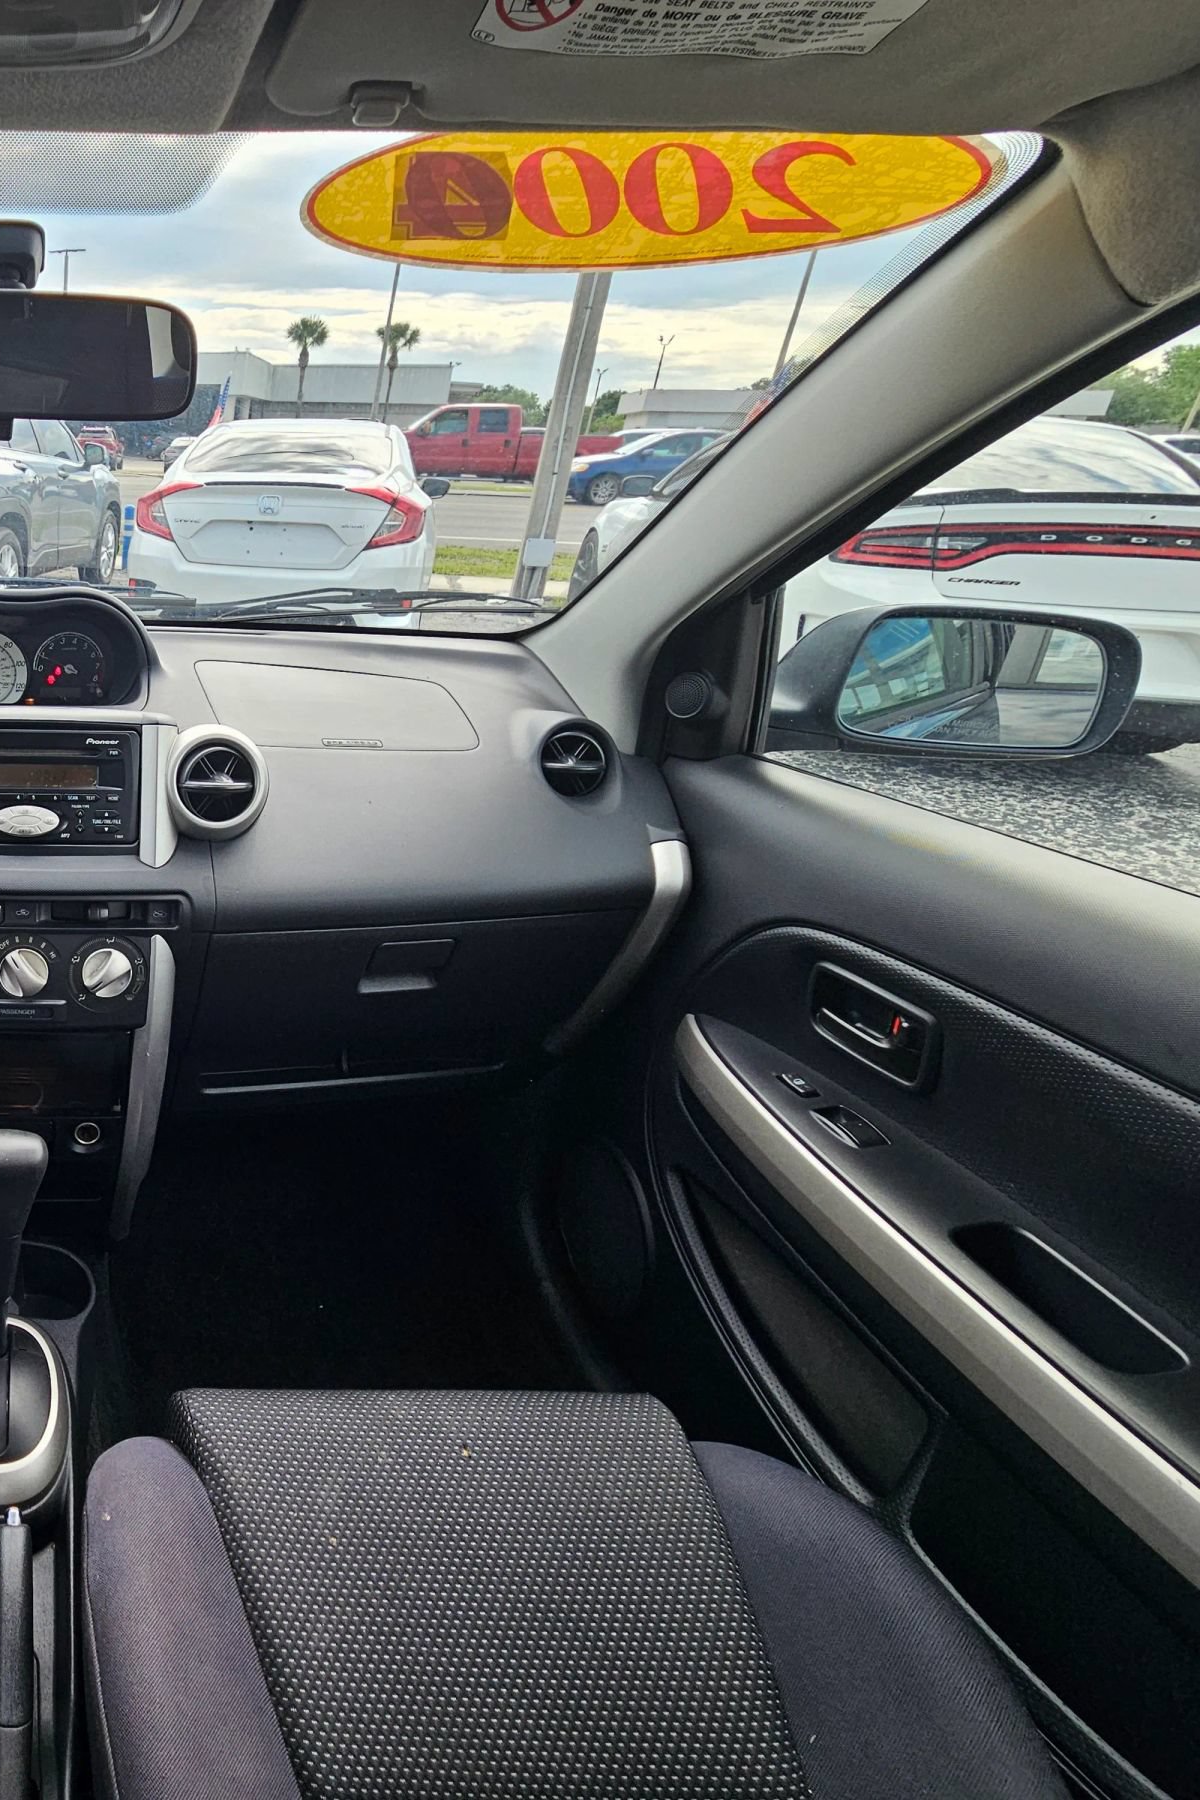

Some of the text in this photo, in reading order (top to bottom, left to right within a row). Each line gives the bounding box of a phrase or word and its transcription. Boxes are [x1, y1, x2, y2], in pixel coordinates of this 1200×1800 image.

[699, 0, 735, 9] BELTS
[765, 1, 799, 9] CHILD
[595, 3, 638, 16] Danger
[642, 9, 657, 17] de
[662, 11, 701, 21] MORT
[746, 10, 818, 19] BLESSURE
[821, 11, 868, 20] GRAVE
[947, 576, 1021, 586] CHARGER
[3, 641, 14, 649] 80
[85, 737, 120, 745] Pioneer
